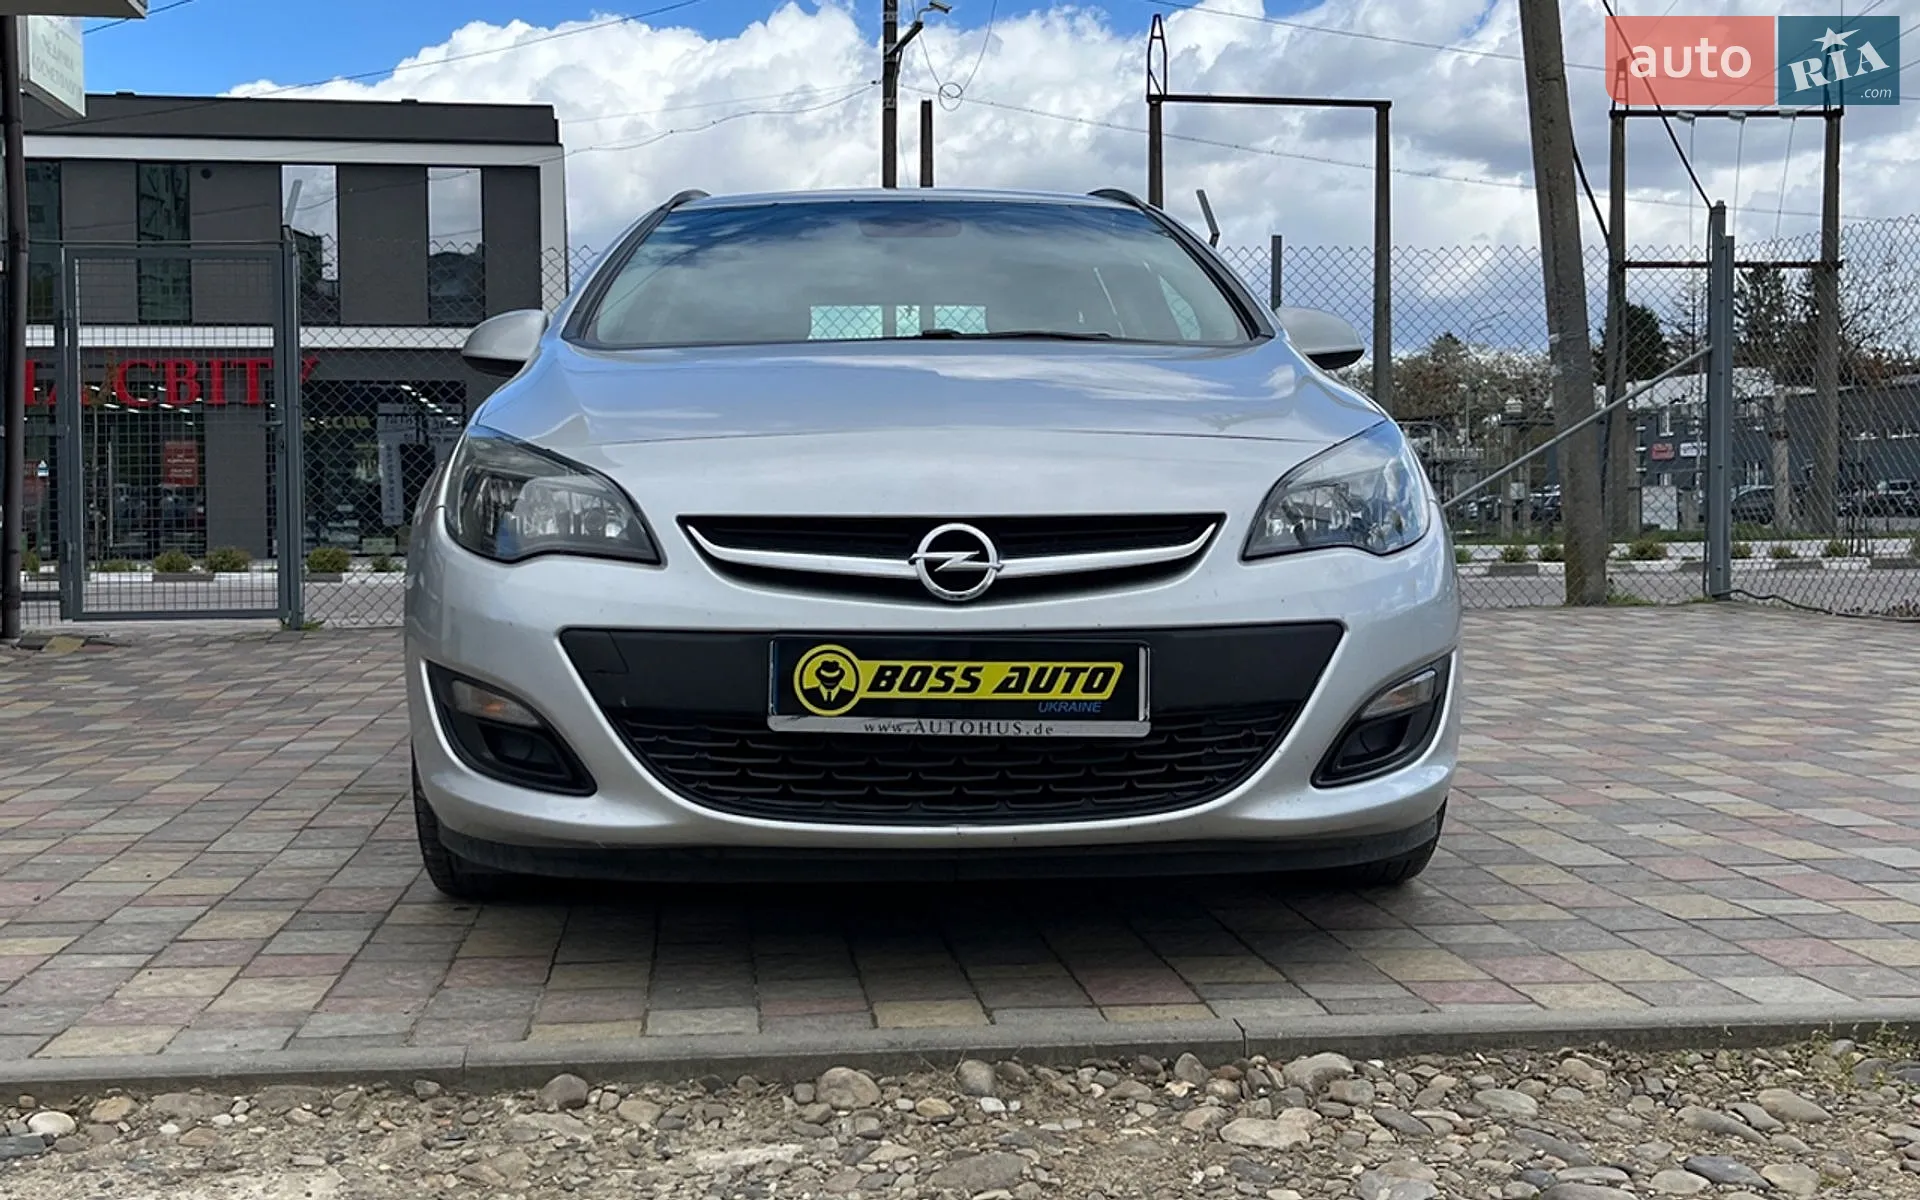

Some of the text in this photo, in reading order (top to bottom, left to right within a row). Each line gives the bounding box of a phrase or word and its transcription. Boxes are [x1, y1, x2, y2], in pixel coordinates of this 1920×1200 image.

[866, 664, 1116, 696] BOSS AUTO
[1037, 700, 1103, 714] UKRAINE
[863, 718, 1055, 737] www.AUTOHUS.de
